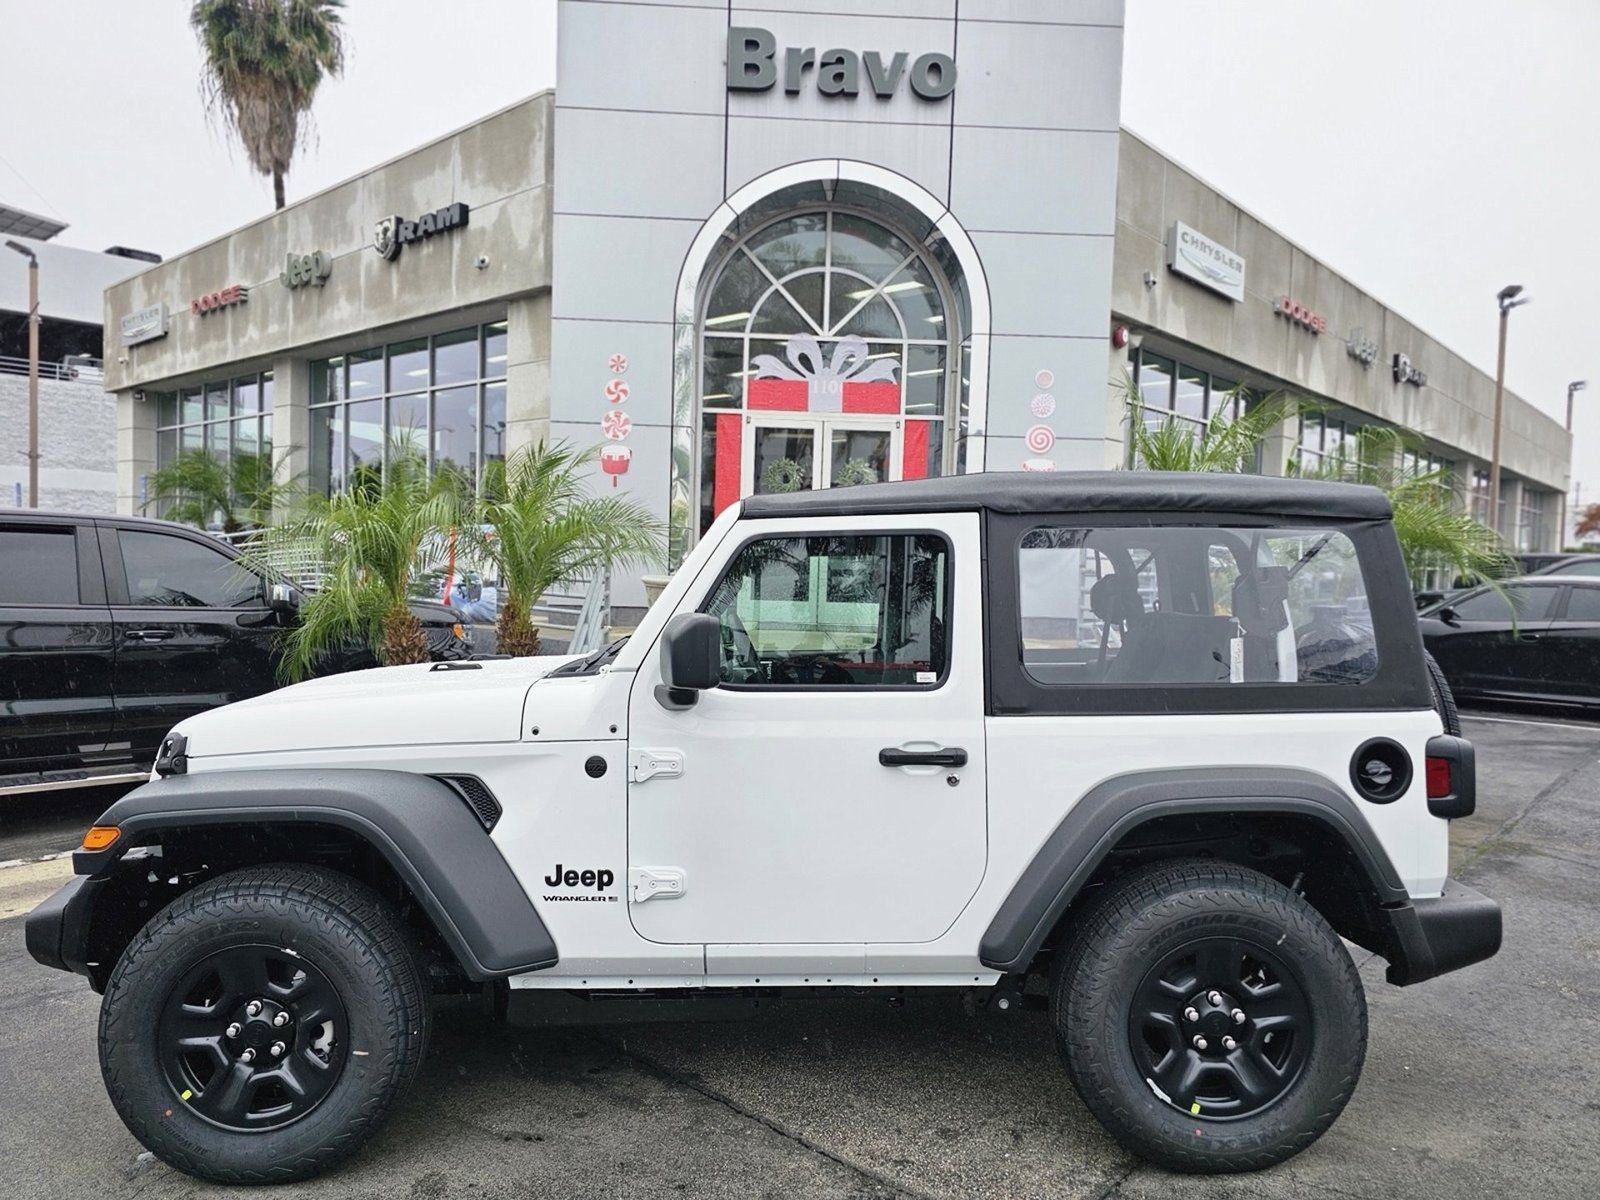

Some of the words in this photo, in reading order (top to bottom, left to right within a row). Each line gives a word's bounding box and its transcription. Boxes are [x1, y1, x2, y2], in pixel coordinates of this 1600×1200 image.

[727, 27, 957, 100] Bravo
[399, 203, 465, 243] RAM
[280, 250, 329, 290] Jeep
[1181, 231, 1242, 273] CHRYSLER
[192, 284, 243, 316] DODGE
[1281, 296, 1327, 334] DODGE
[544, 863, 614, 892] Jeep
